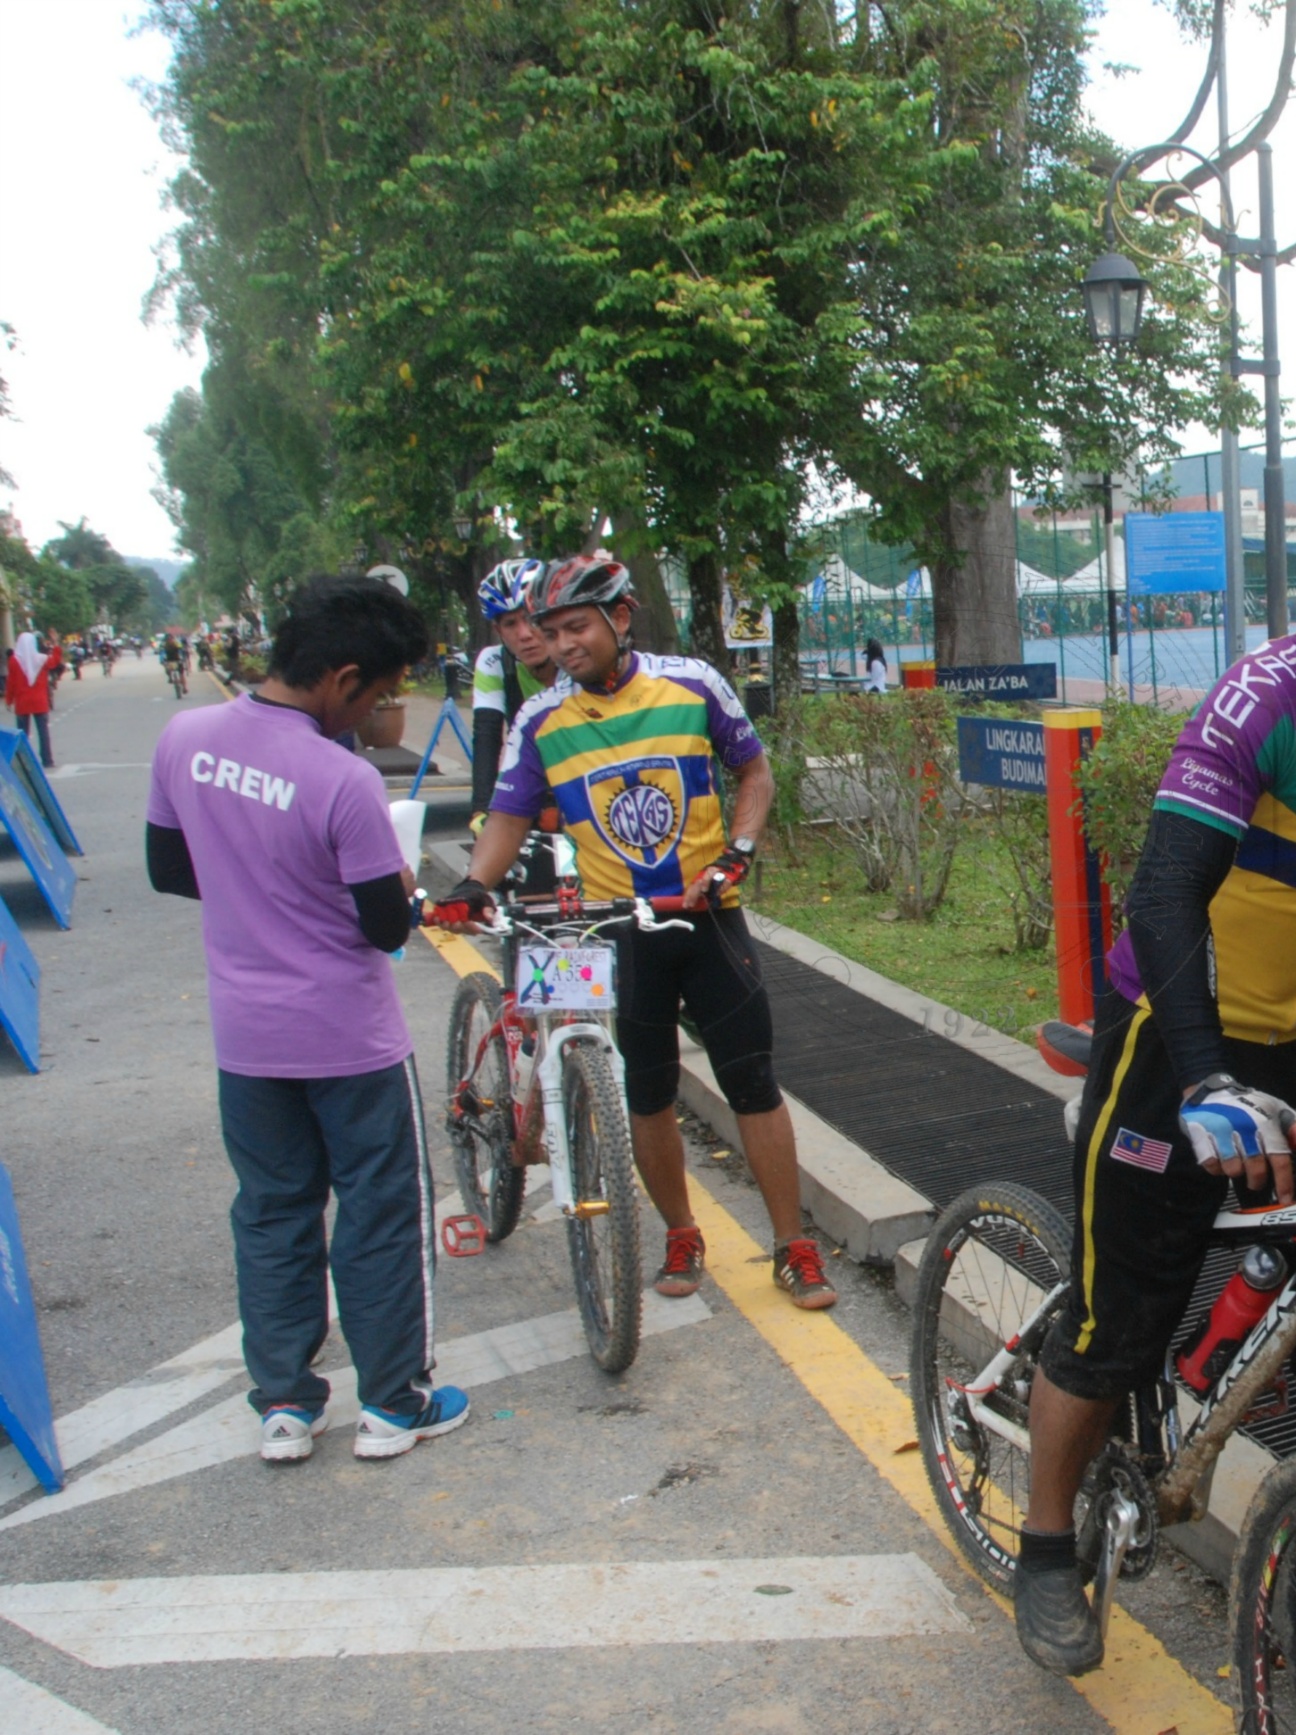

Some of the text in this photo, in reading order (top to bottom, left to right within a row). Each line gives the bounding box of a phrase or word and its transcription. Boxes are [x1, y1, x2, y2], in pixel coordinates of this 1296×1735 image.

[943, 675, 1029, 693] JALAN ZA'BA
[985, 727, 1047, 757] LINGKARA
[190, 750, 297, 812] CREW
[1001, 758, 1047, 784] BUDIMA
[1181, 771, 1220, 796] Cycle
[609, 786, 671, 846] TEKAS
